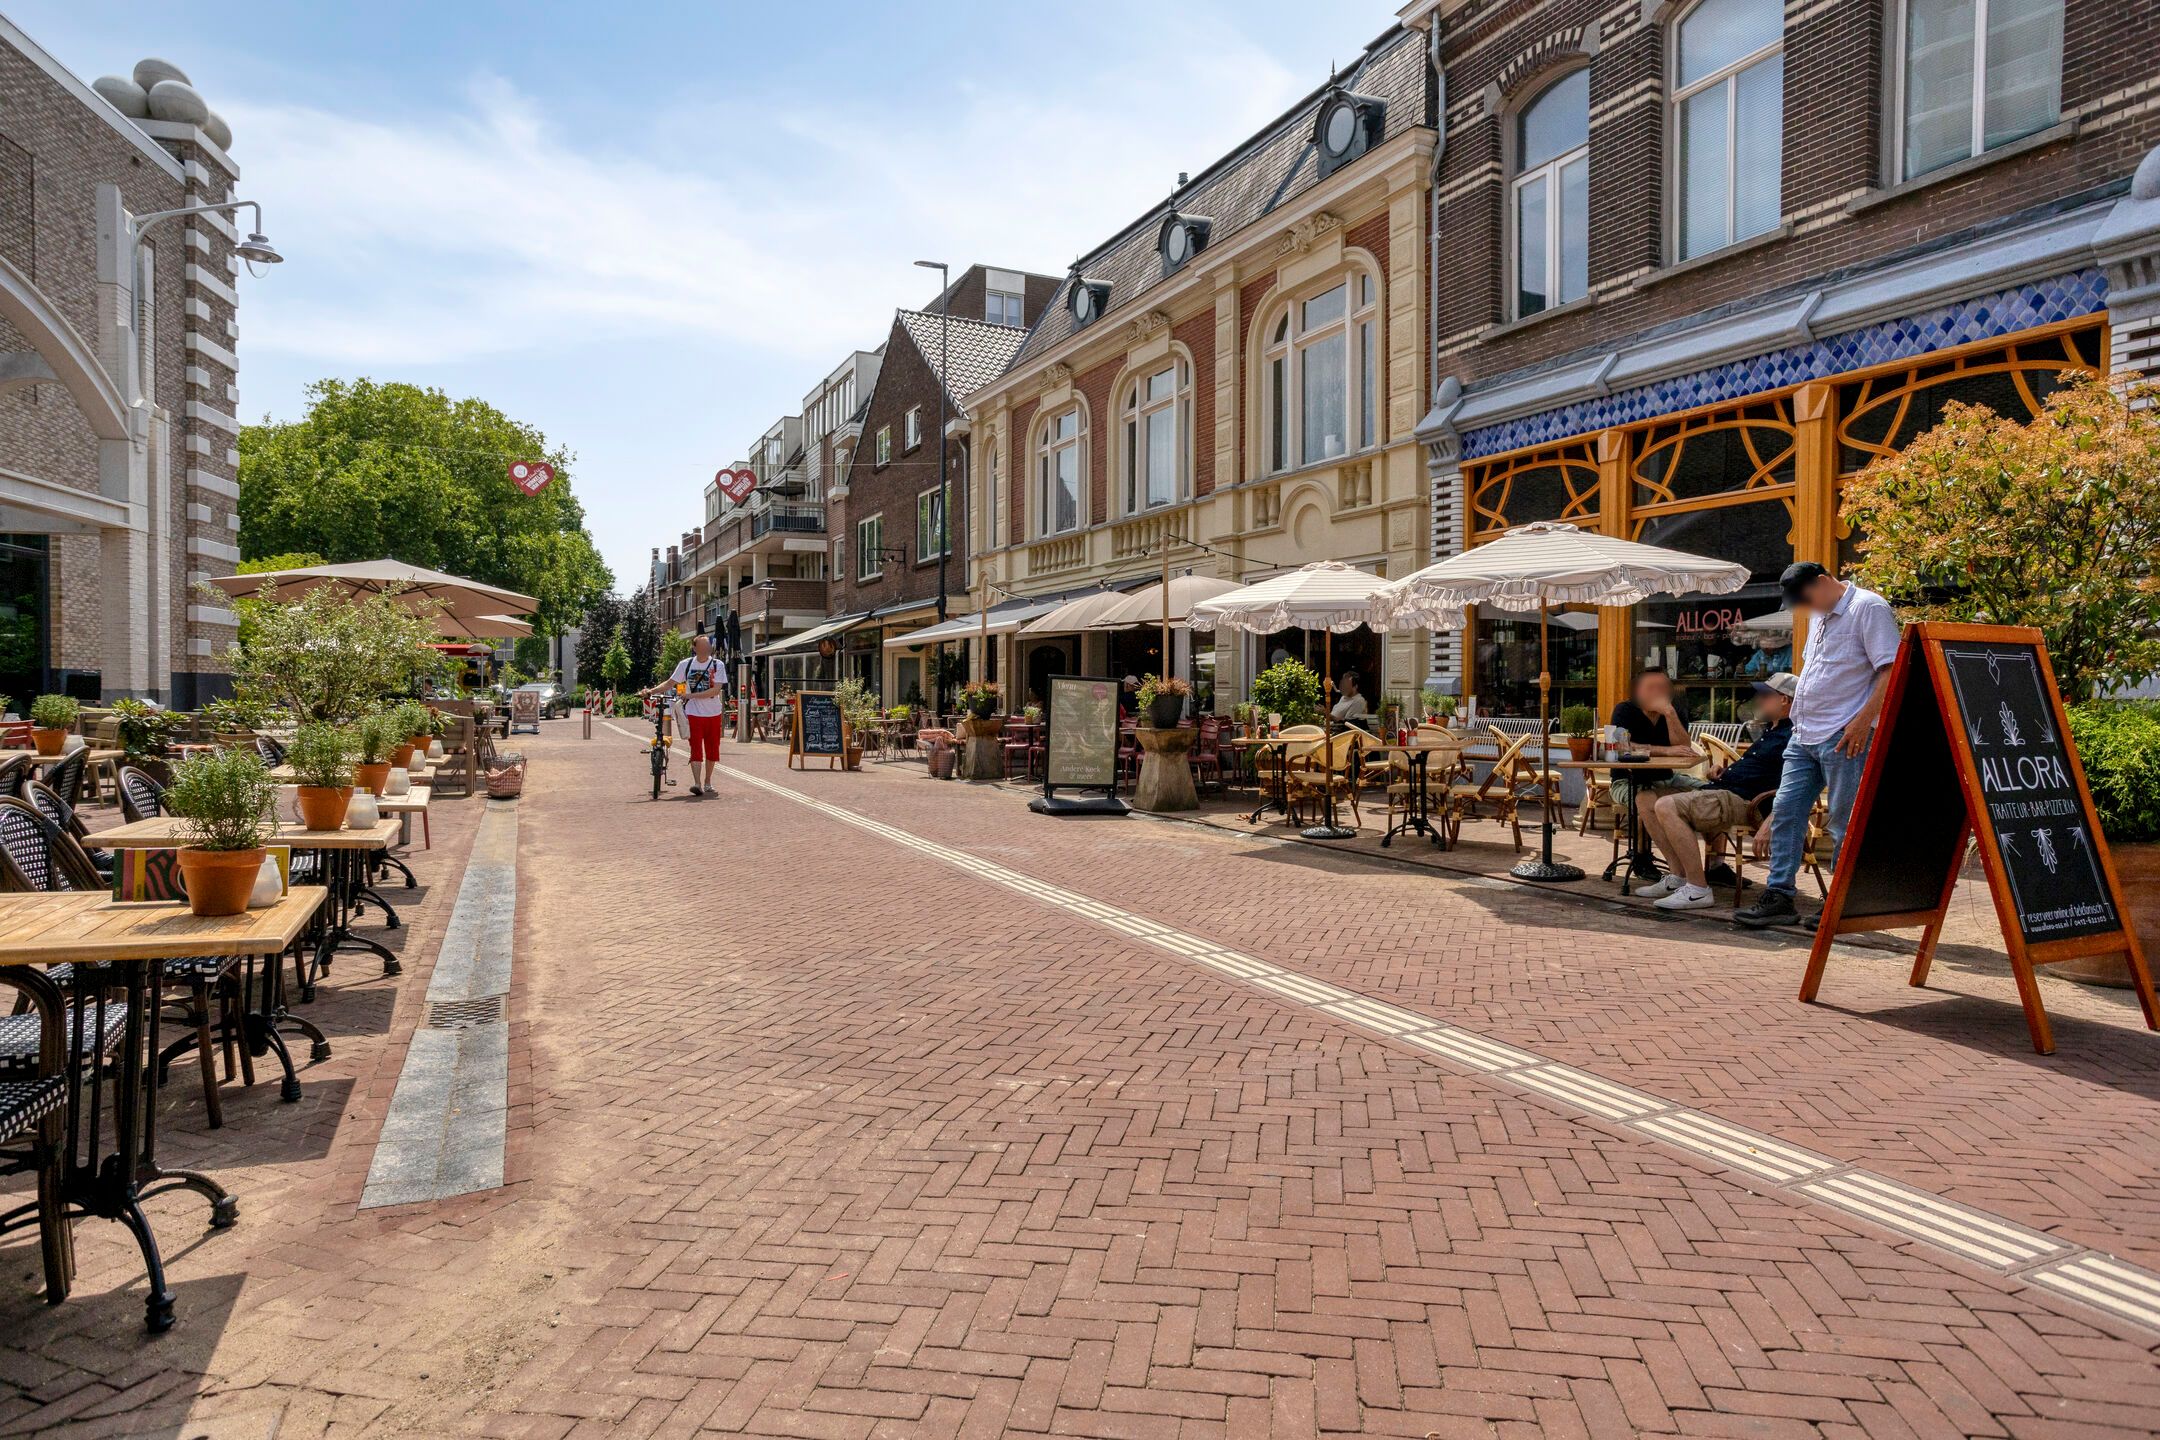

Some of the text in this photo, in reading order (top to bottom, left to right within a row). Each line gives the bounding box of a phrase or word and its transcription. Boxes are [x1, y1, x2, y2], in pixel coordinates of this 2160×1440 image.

[1676, 608, 1744, 633] ALLORA
[1982, 756, 2069, 792] ALLORA
[2054, 907, 2069, 919] online
